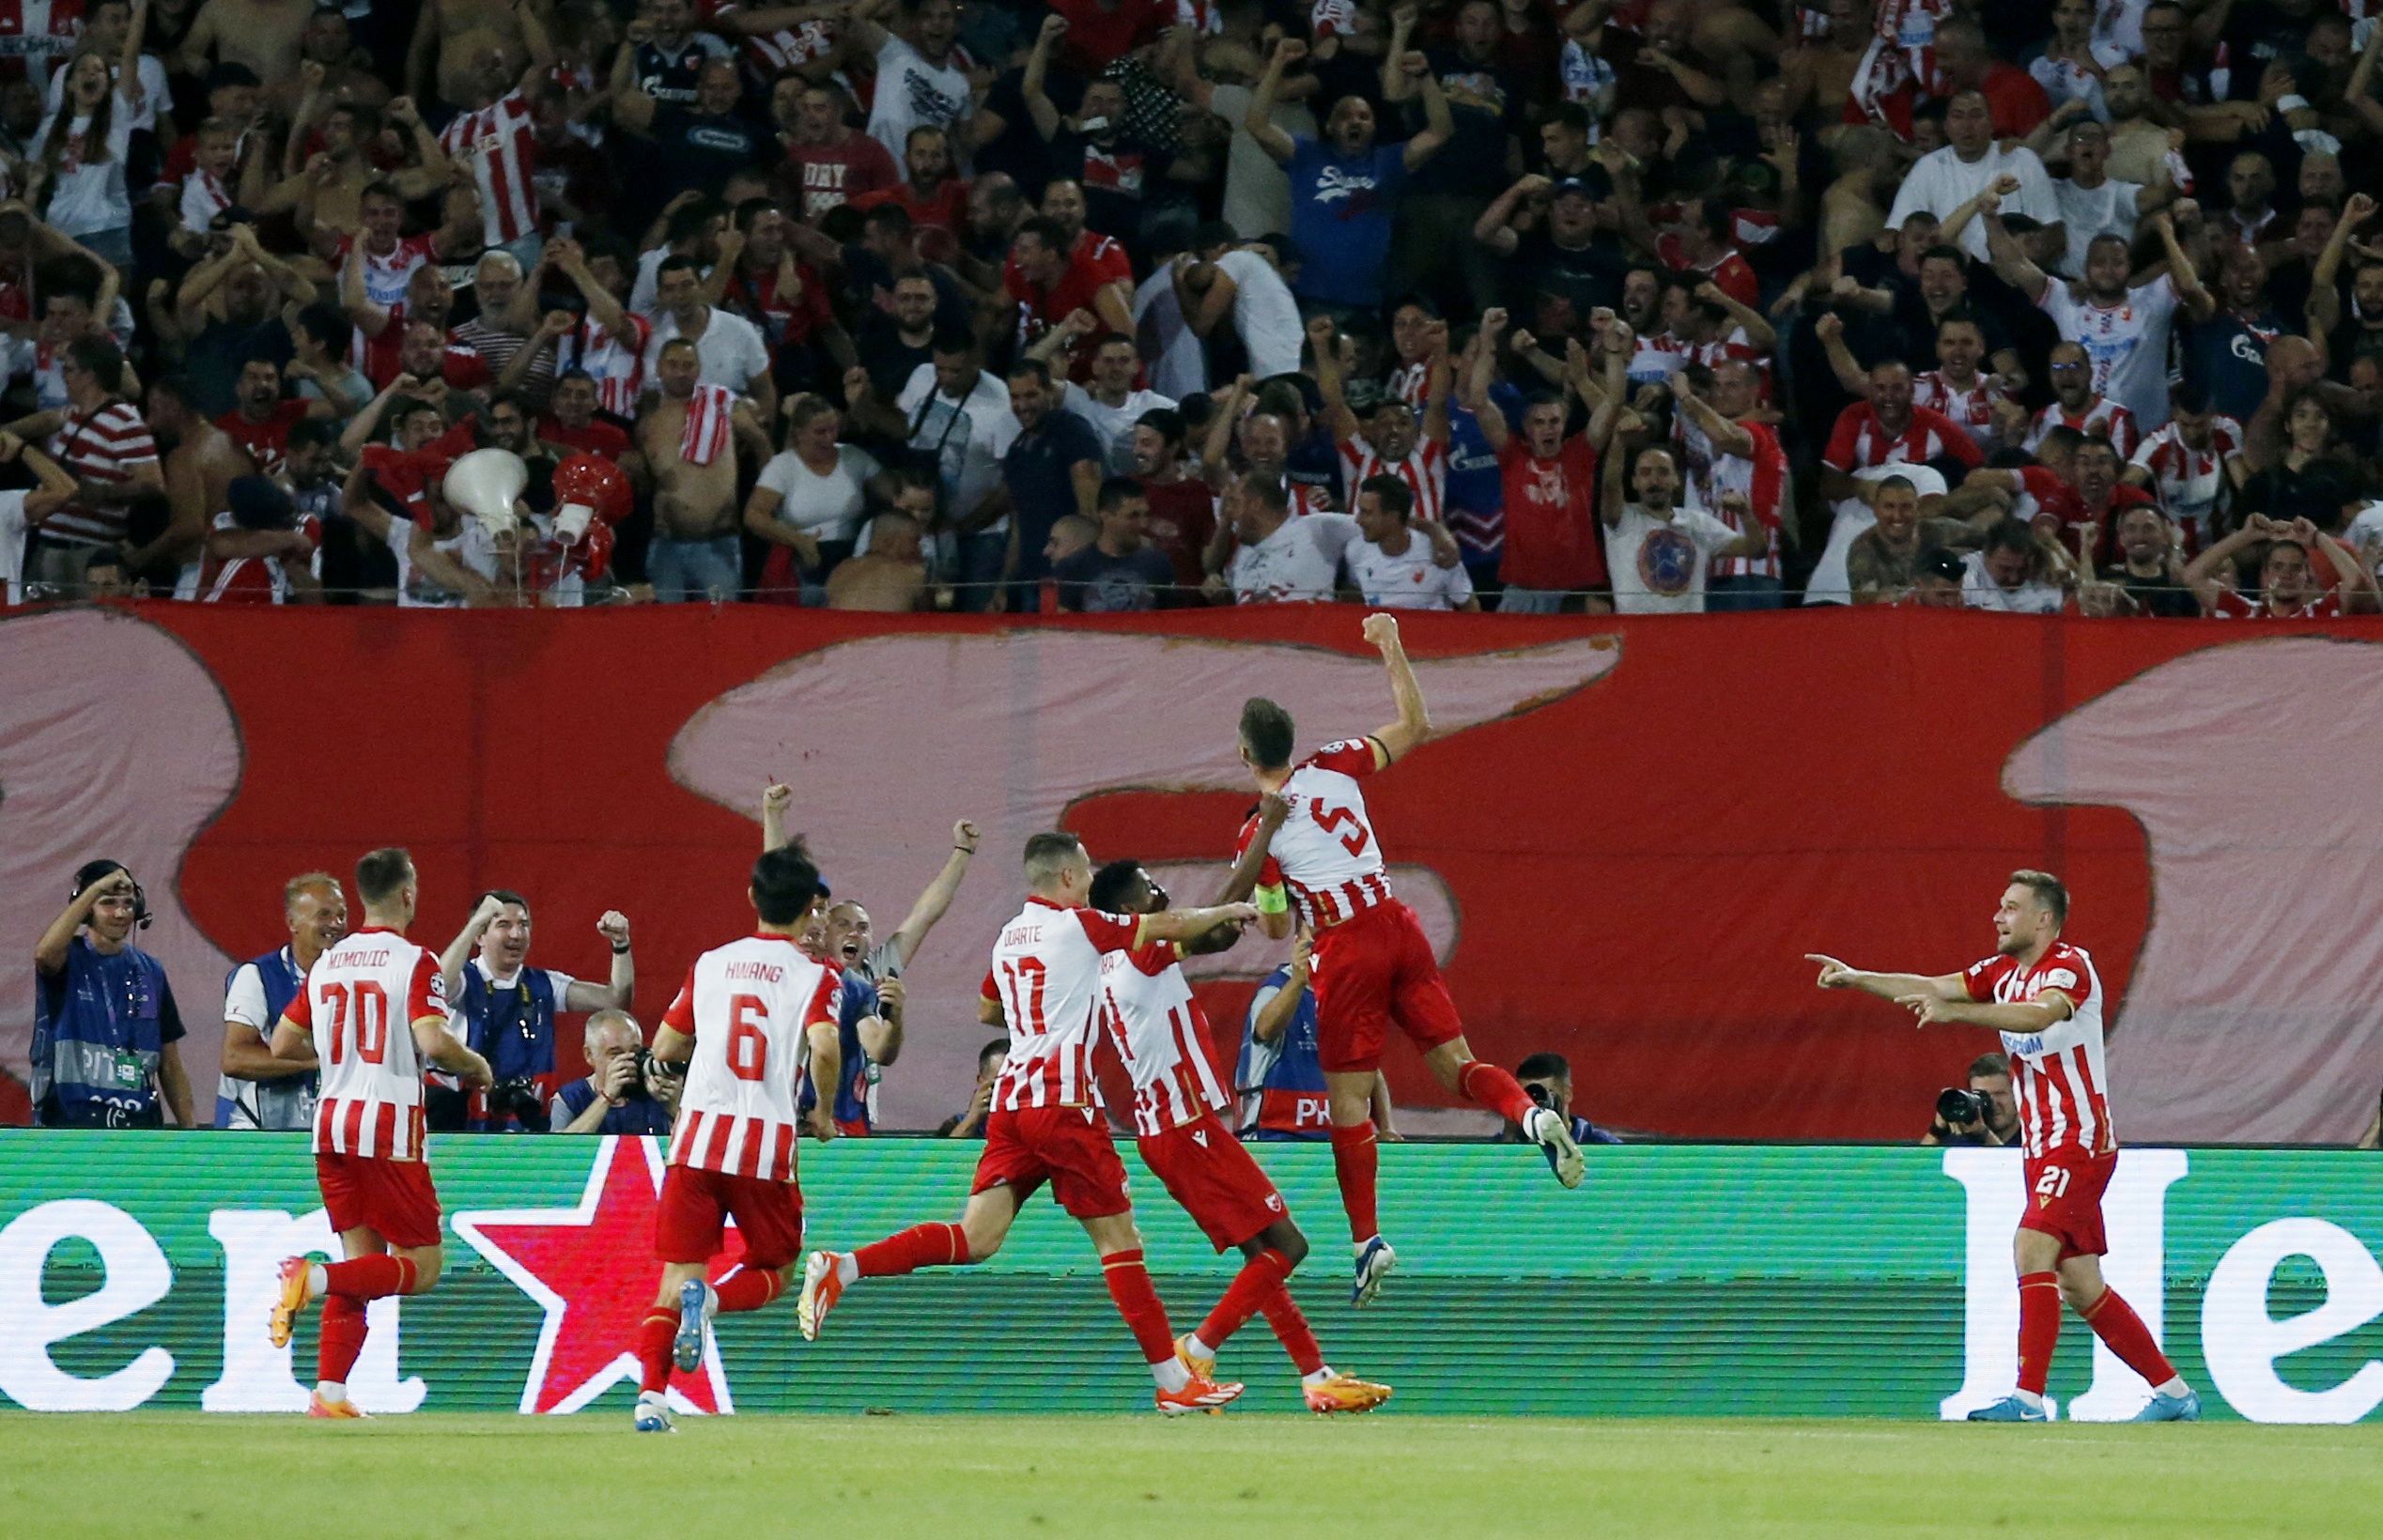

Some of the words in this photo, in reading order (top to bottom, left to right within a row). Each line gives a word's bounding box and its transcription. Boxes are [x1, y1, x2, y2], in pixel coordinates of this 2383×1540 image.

[804, 162, 847, 188] DAY
[1309, 797, 1369, 857] 5
[1004, 925, 1044, 947] DUARTE
[725, 962, 783, 983] HWANG
[1001, 956, 1046, 1037] 17
[320, 979, 387, 1064] 70
[726, 993, 768, 1081] 6
[82, 1041, 115, 1082] PIT
[1295, 1098, 1331, 1126] PH
[2035, 1164, 2071, 1198] 21
[0, 1198, 427, 1412] en
[1940, 1147, 2383, 1425] He
